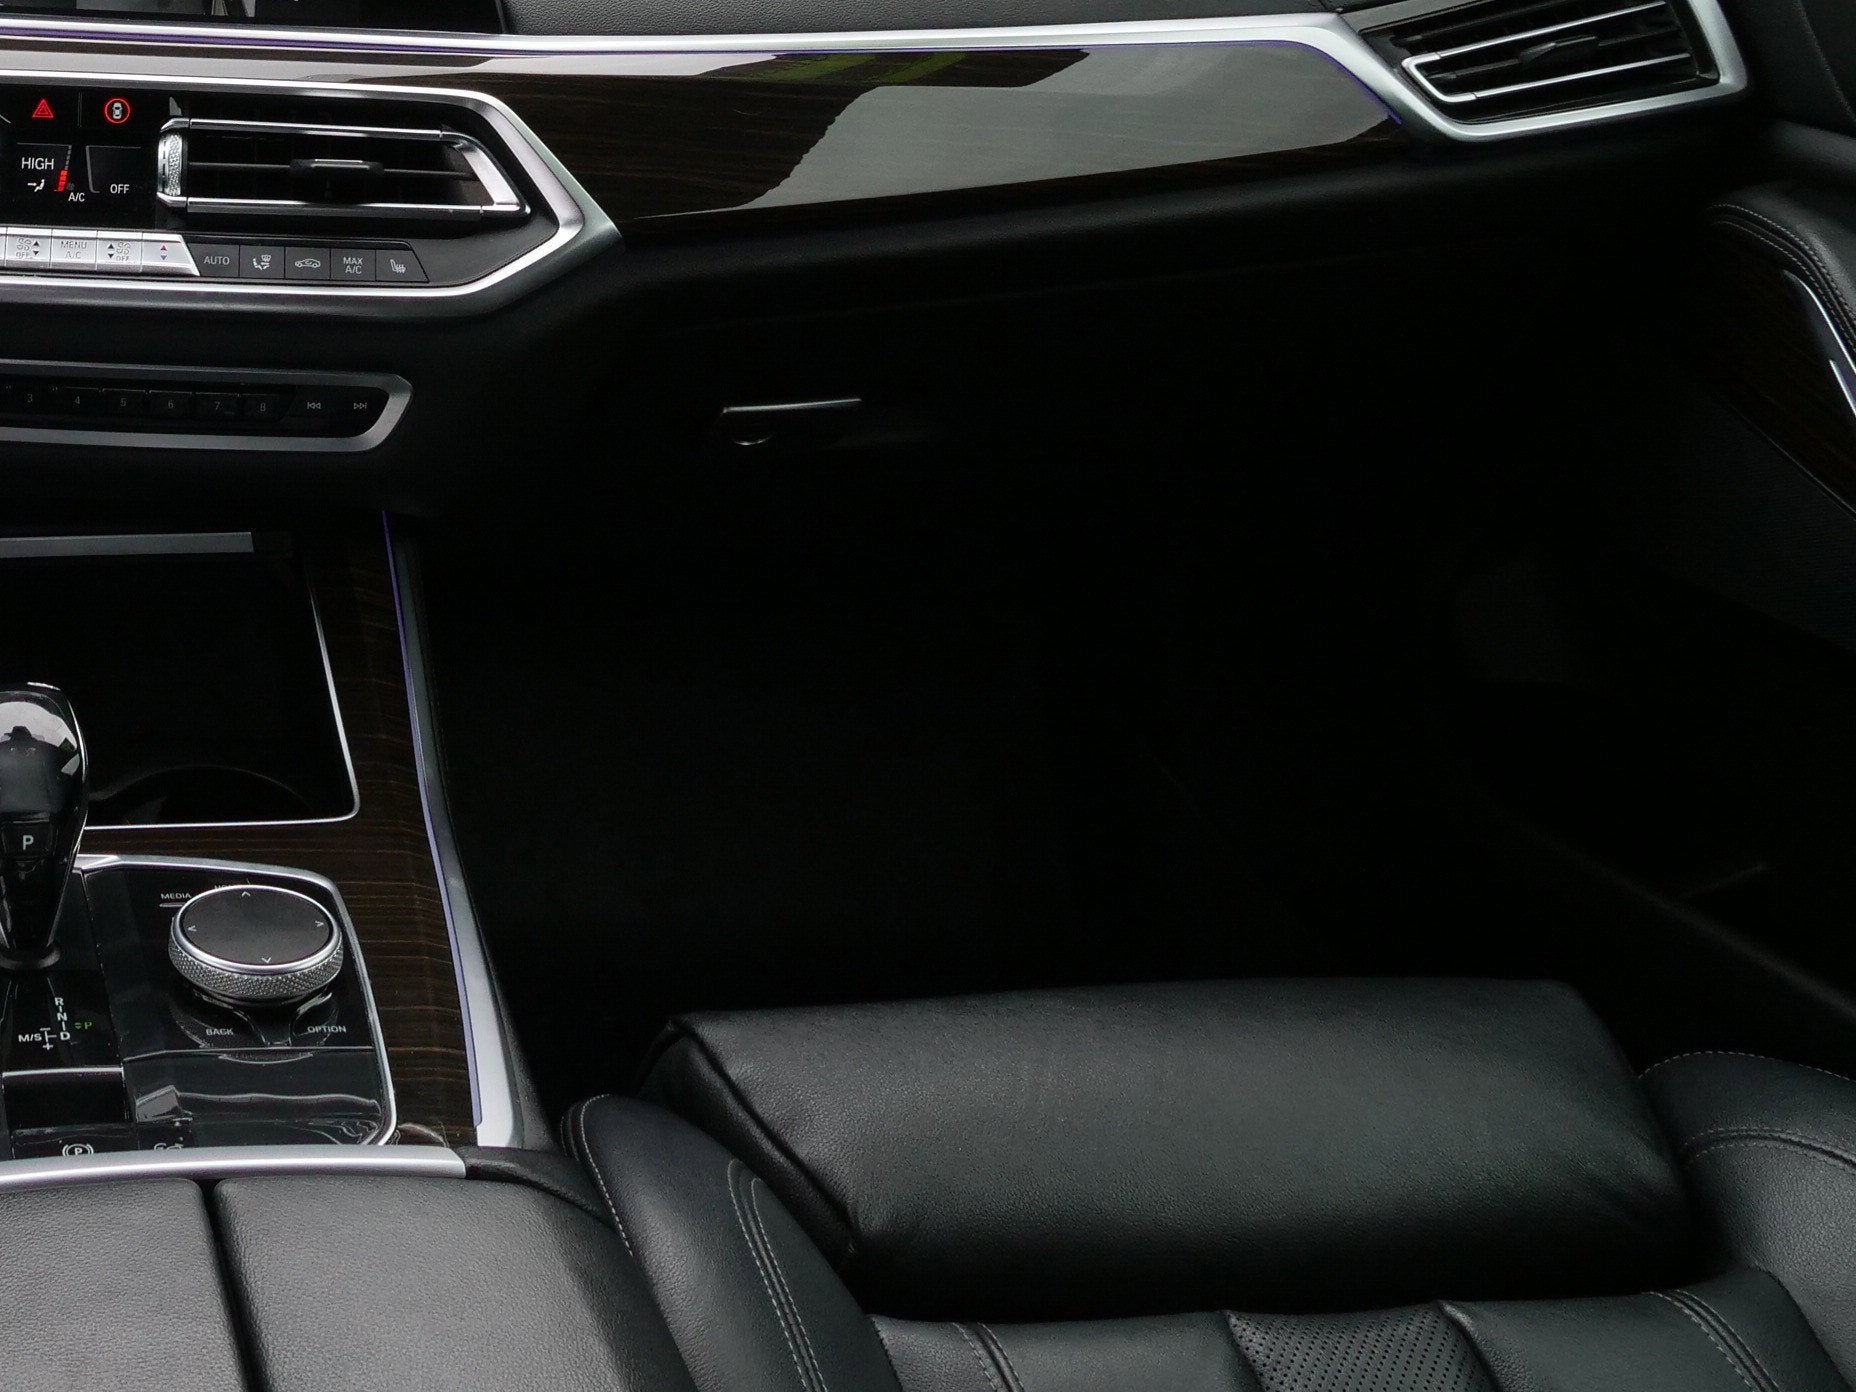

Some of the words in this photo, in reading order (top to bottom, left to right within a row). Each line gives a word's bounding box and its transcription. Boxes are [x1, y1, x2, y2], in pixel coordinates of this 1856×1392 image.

[21, 157, 55, 170] HIGH
[110, 184, 130, 194] OFF
[68, 192, 85, 202] A/C
[60, 240, 88, 250] MENU
[203, 256, 230, 266] AUTO
[343, 257, 363, 266] MAX
[345, 265, 362, 275] A/C
[23, 835, 34, 850] P
[160, 892, 192, 900] MEDIA
[54, 997, 64, 1006] R
[57, 1012, 68, 1021] N
[84, 1021, 93, 1030] P
[307, 1025, 347, 1033] OPTION
[60, 1031, 71, 1041] D
[205, 1028, 234, 1036] BACK
[18, 1033, 42, 1043] M/S
